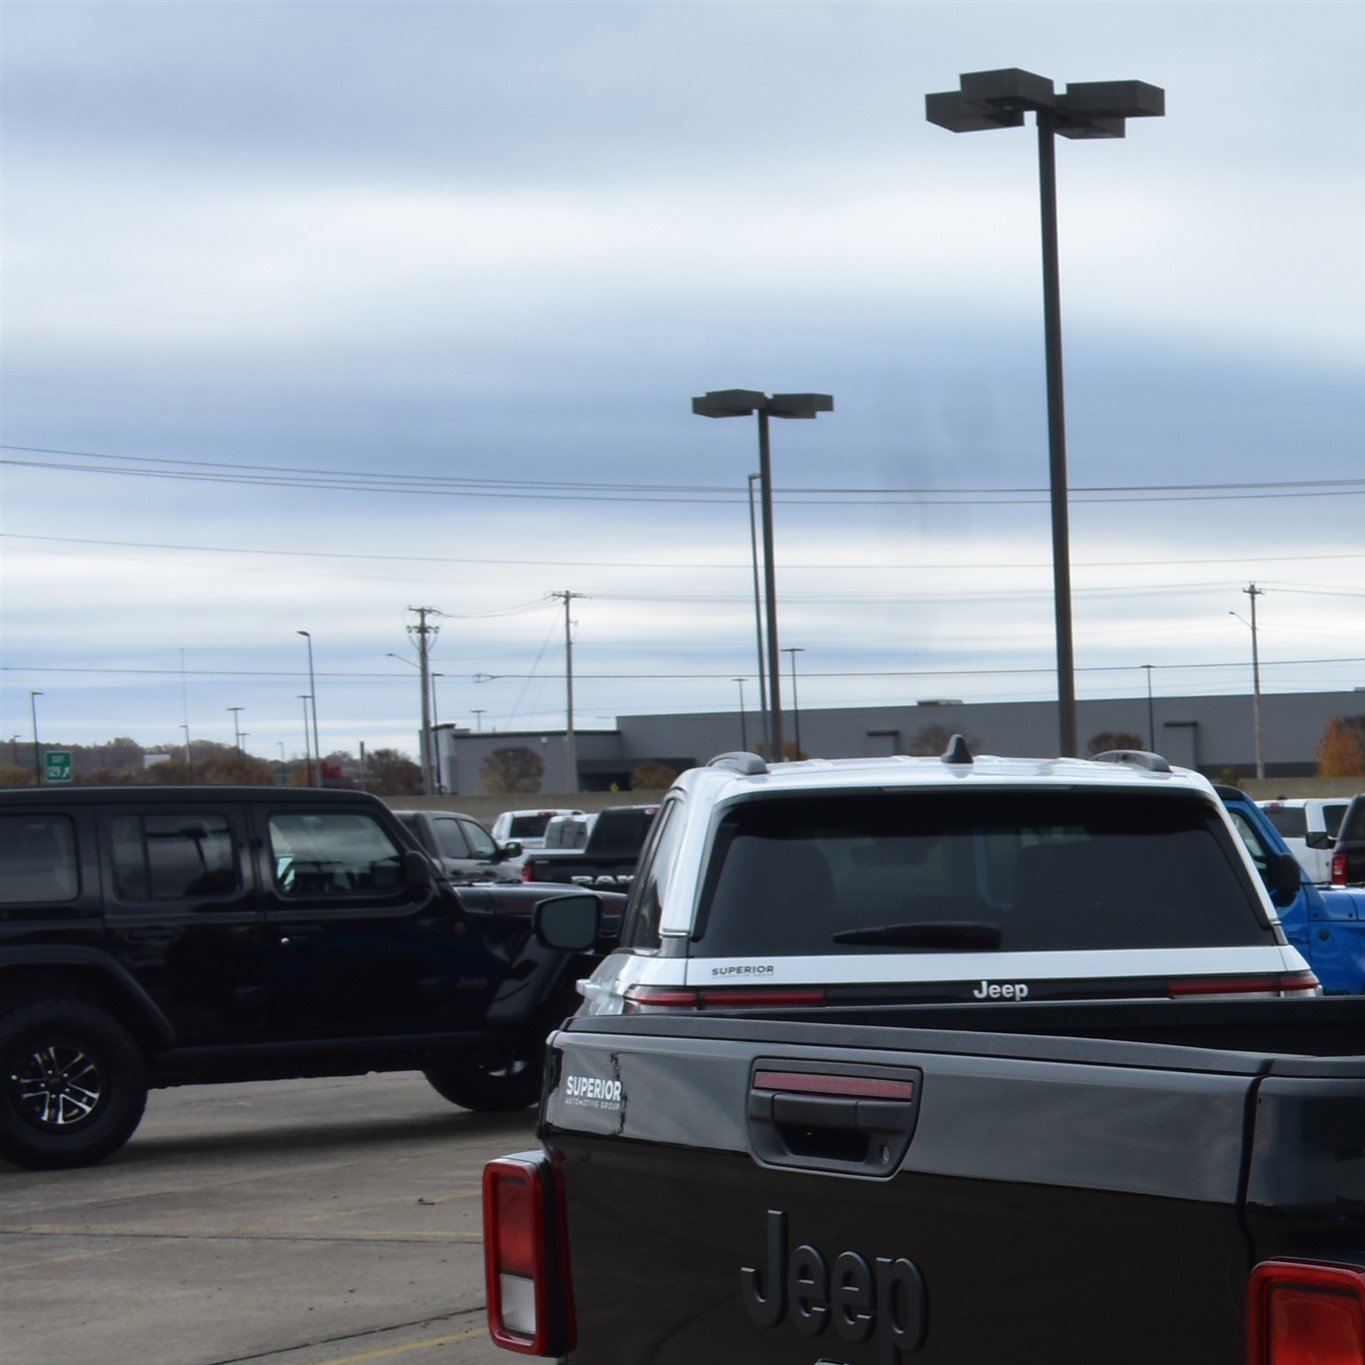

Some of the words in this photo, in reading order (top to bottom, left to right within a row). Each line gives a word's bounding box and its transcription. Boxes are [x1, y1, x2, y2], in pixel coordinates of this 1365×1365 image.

[712, 965, 774, 976] SUPERIOR
[973, 980, 1028, 1001] Jeep
[566, 1076, 621, 1101] SUPERIOR
